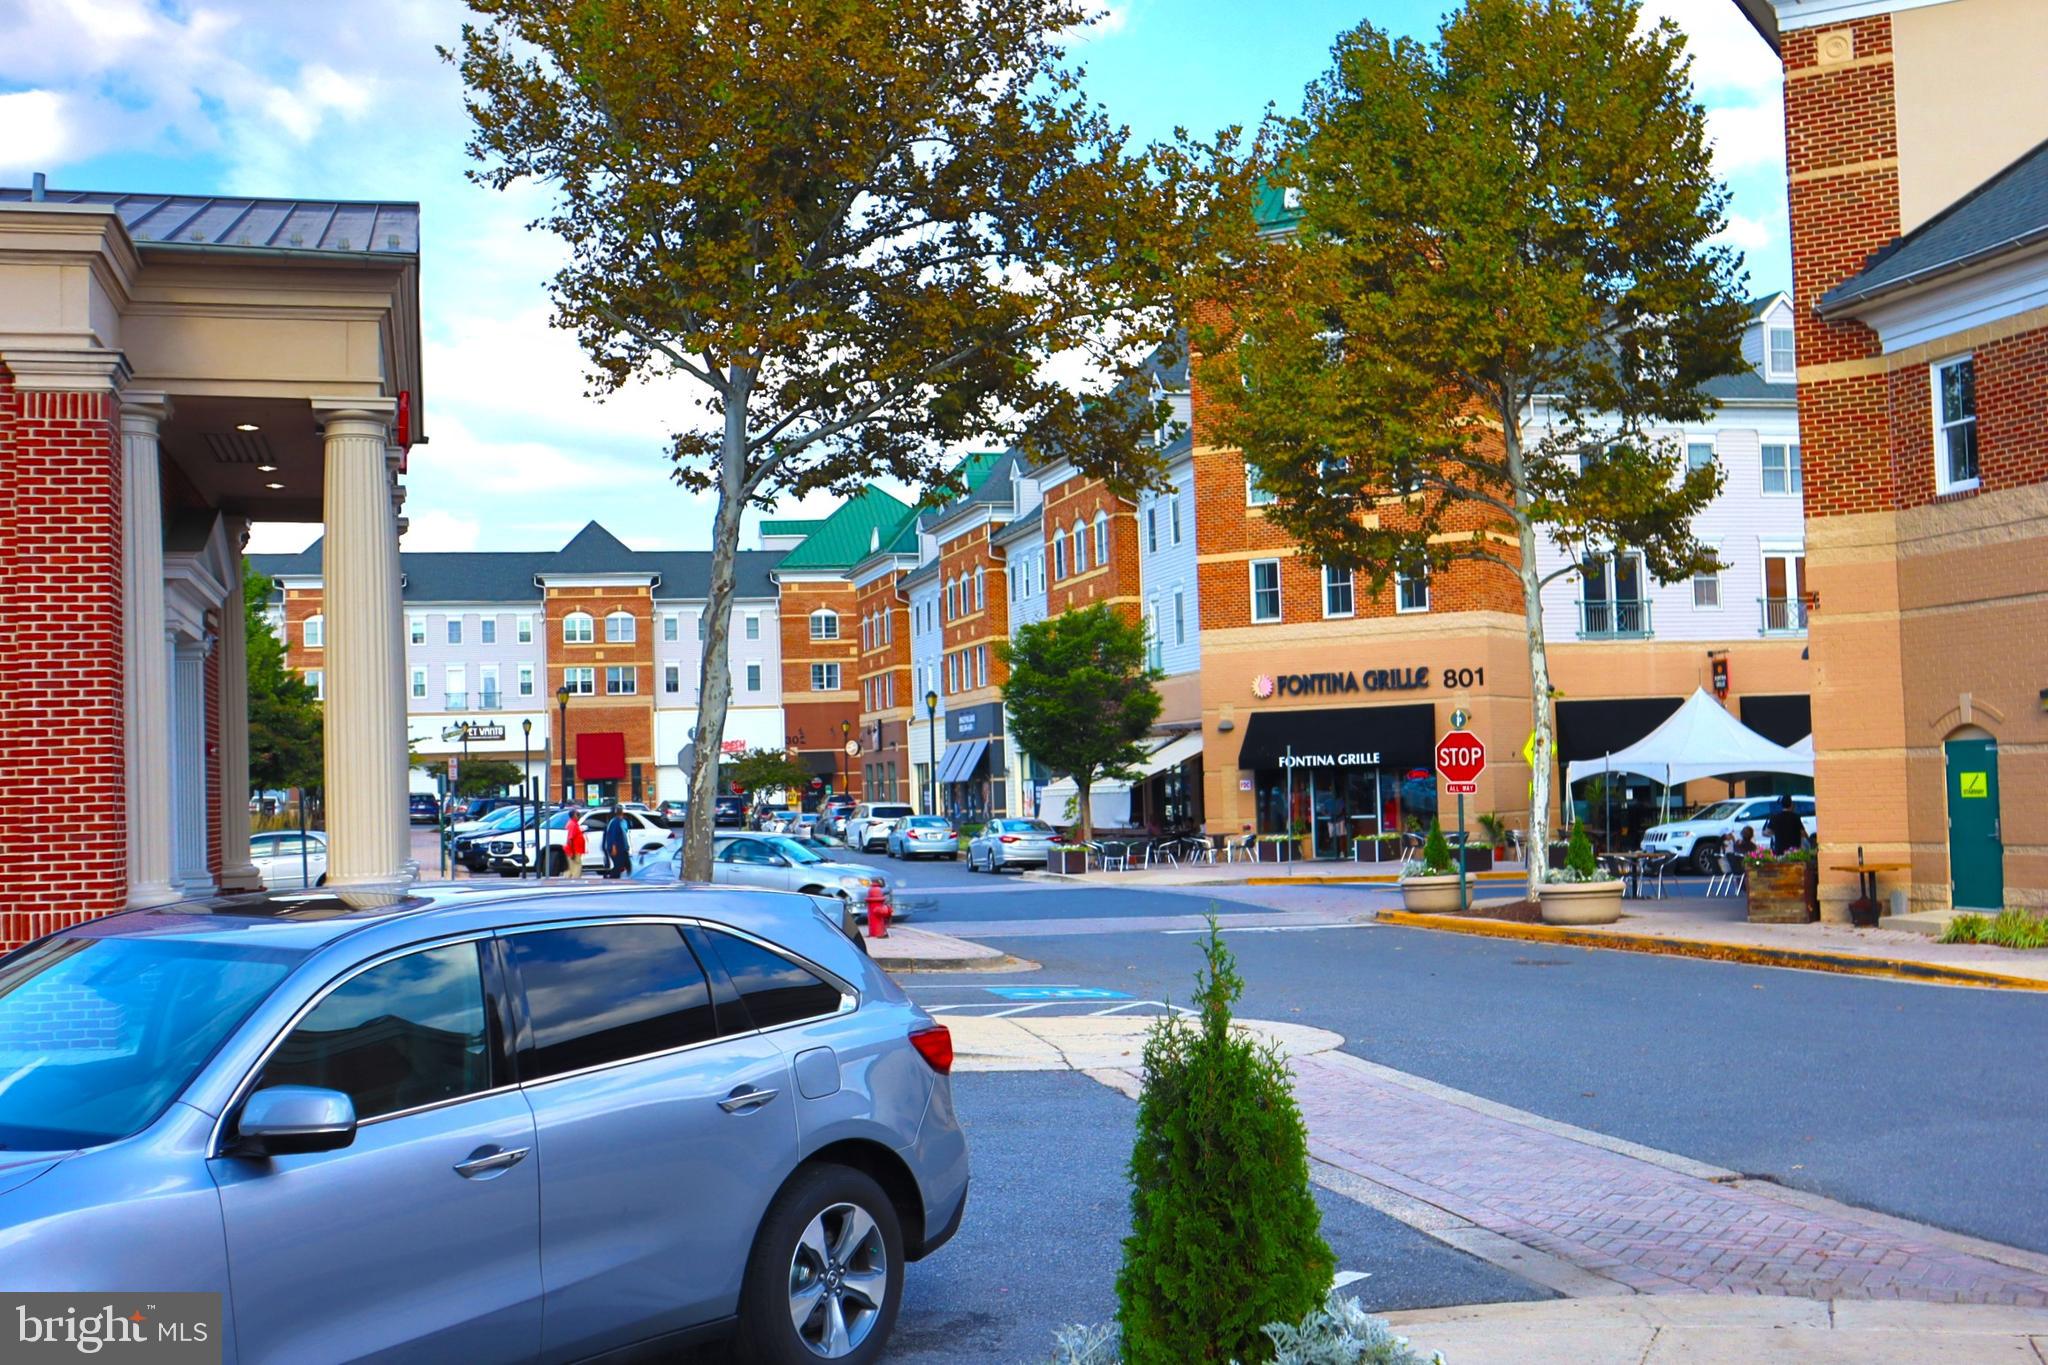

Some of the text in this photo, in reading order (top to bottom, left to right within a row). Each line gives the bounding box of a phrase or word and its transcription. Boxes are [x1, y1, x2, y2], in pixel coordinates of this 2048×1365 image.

[1276, 666, 1430, 697] FONTINA GRILLE
[1443, 667, 1485, 689] 801
[1278, 752, 1381, 769] FONTINA GRILLE
[1439, 747, 1482, 767] STOP
